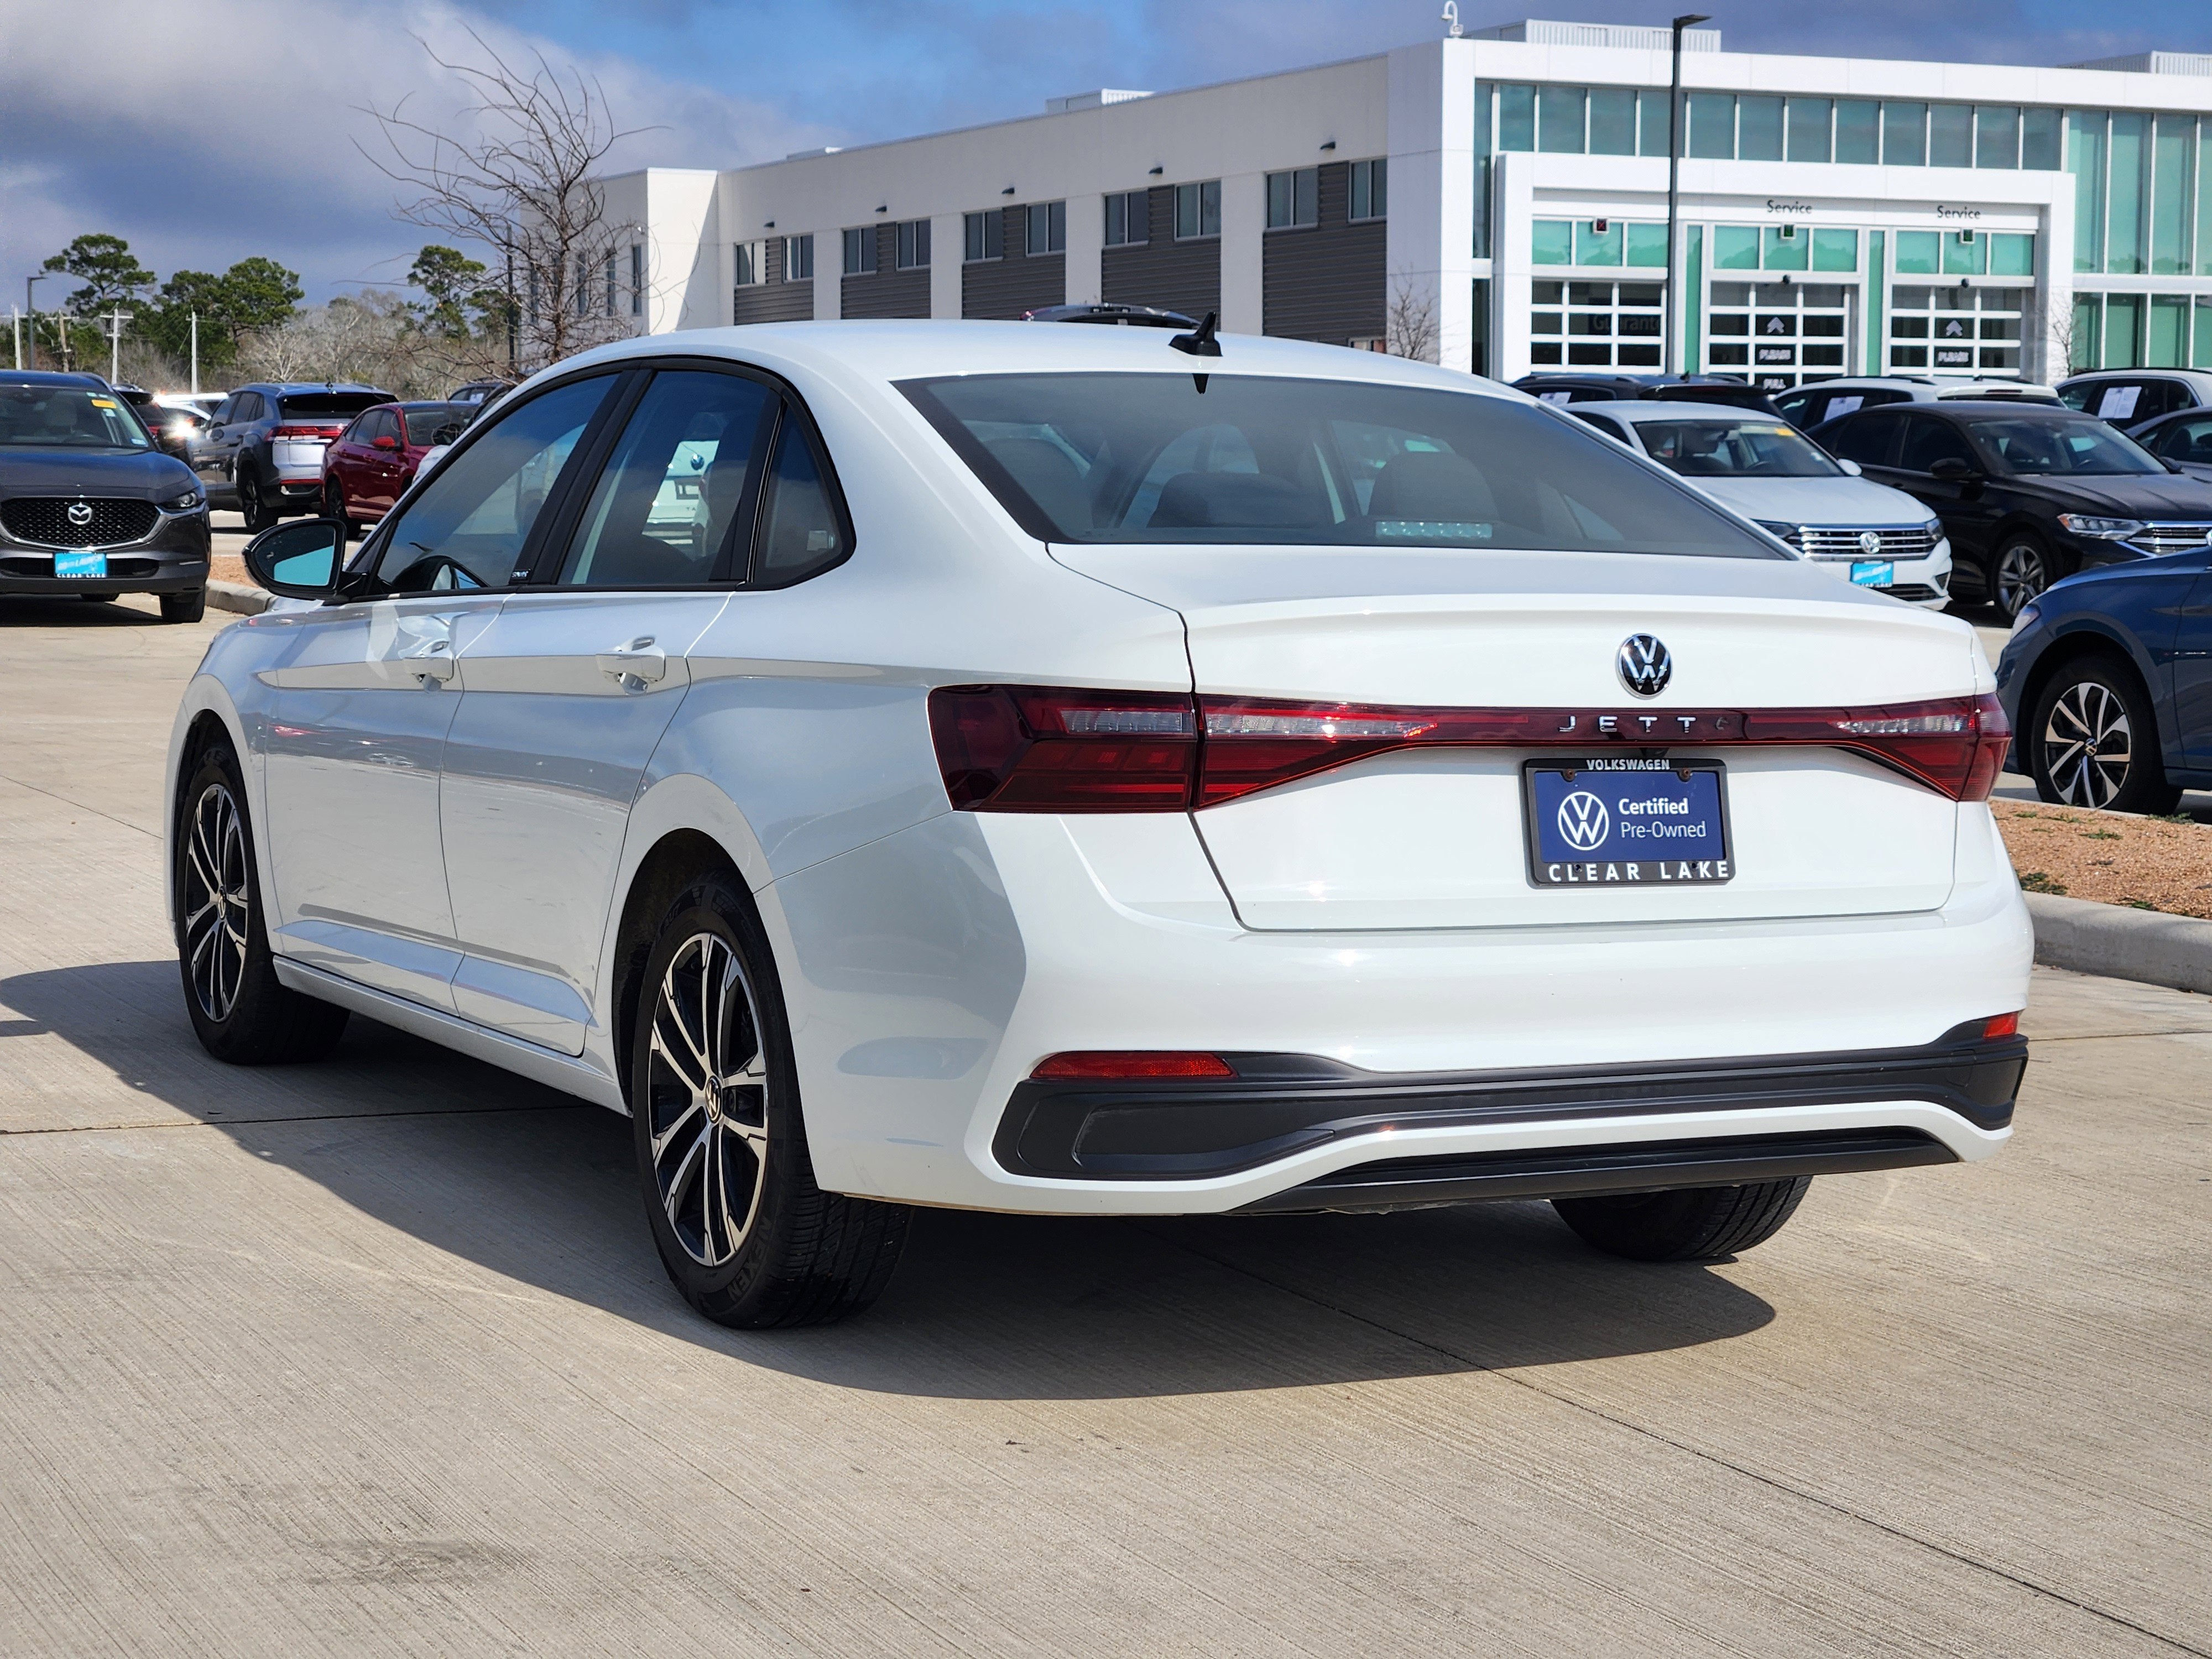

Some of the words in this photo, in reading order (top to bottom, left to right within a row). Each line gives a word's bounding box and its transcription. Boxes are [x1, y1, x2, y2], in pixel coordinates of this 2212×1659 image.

[1766, 200, 1813, 214] Service
[1937, 205, 1981, 220] Service
[1586, 759, 1670, 770] VOLKSWAGEN
[1619, 797, 1689, 815] Certified
[1620, 821, 1707, 838] Pre-Owned
[1549, 863, 1641, 882] CLEAR
[1660, 860, 1729, 880] LAKE
